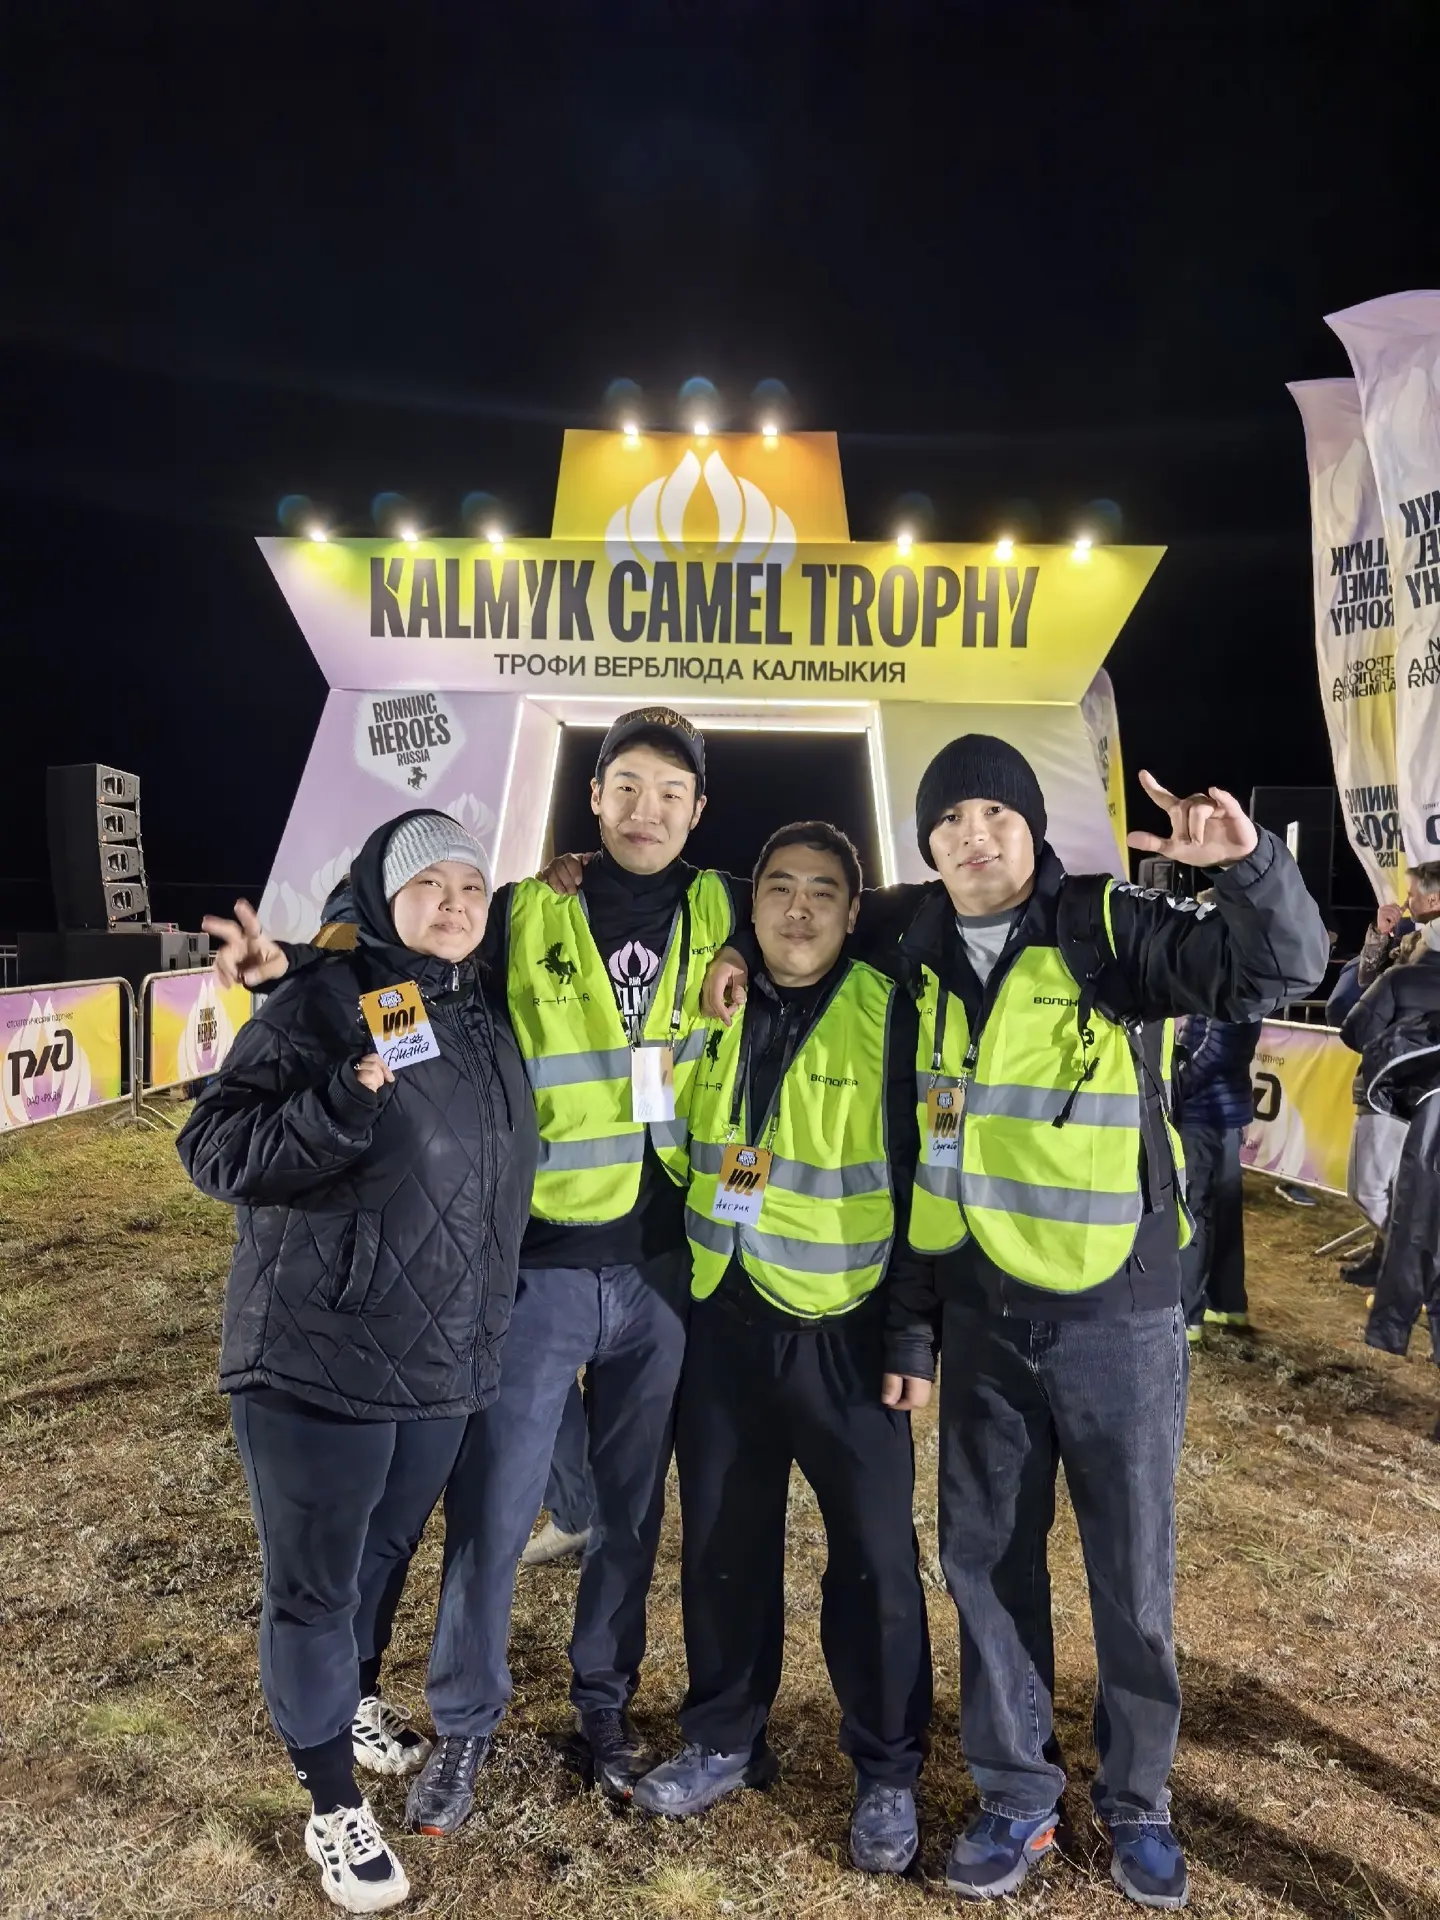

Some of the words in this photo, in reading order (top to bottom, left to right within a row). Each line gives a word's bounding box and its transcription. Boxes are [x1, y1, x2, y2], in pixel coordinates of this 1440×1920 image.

[370, 557, 596, 642] KALMYK
[608, 559, 793, 644] CAMEL
[801, 563, 1040, 649] TROPHY
[494, 653, 586, 677] ТРОФИ
[594, 656, 744, 684] ВЕРБЛЮДА
[753, 659, 906, 683] КАЛМЫКИЯ
[372, 693, 438, 723] RUNNING
[368, 713, 451, 756] HEROES
[397, 749, 431, 766] RUSSIA
[1033, 996, 1078, 1007] ВОЛОН
[383, 1006, 418, 1042] VOL
[383, 1042, 430, 1067] Диана
[723, 1168, 762, 1197] VOL
